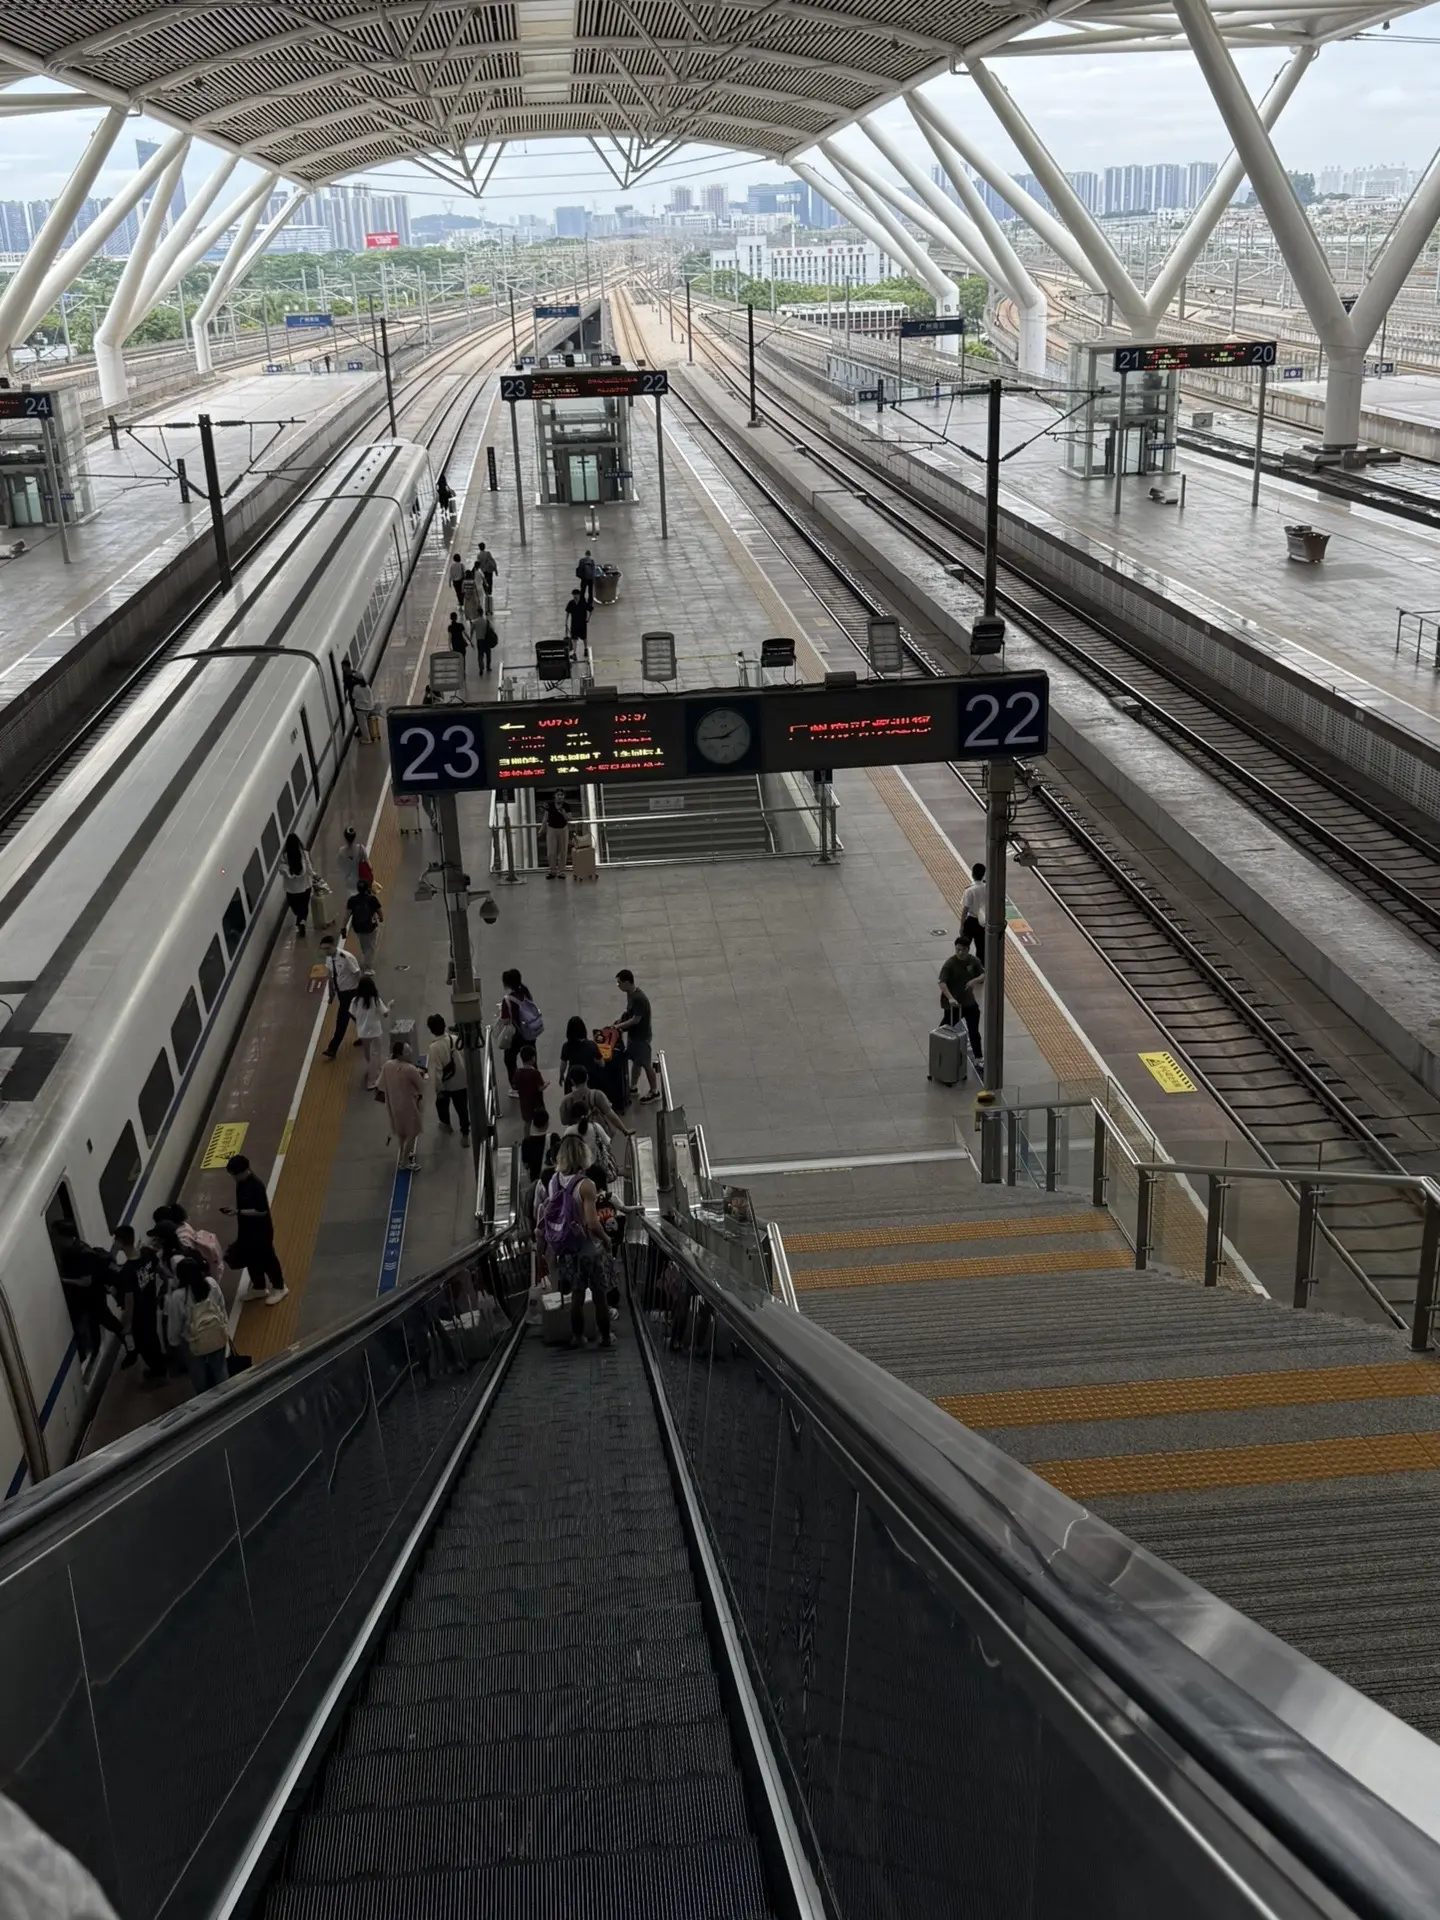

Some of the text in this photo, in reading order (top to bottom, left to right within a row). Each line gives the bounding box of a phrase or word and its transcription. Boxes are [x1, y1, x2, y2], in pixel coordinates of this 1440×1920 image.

[1119, 351, 1140, 369] 21
[1252, 345, 1274, 363] 20
[503, 379, 527, 397] 23
[643, 374, 666, 392] 22
[24, 396, 50, 415] 24
[964, 691, 1041, 748] 22
[399, 725, 480, 782] 23
